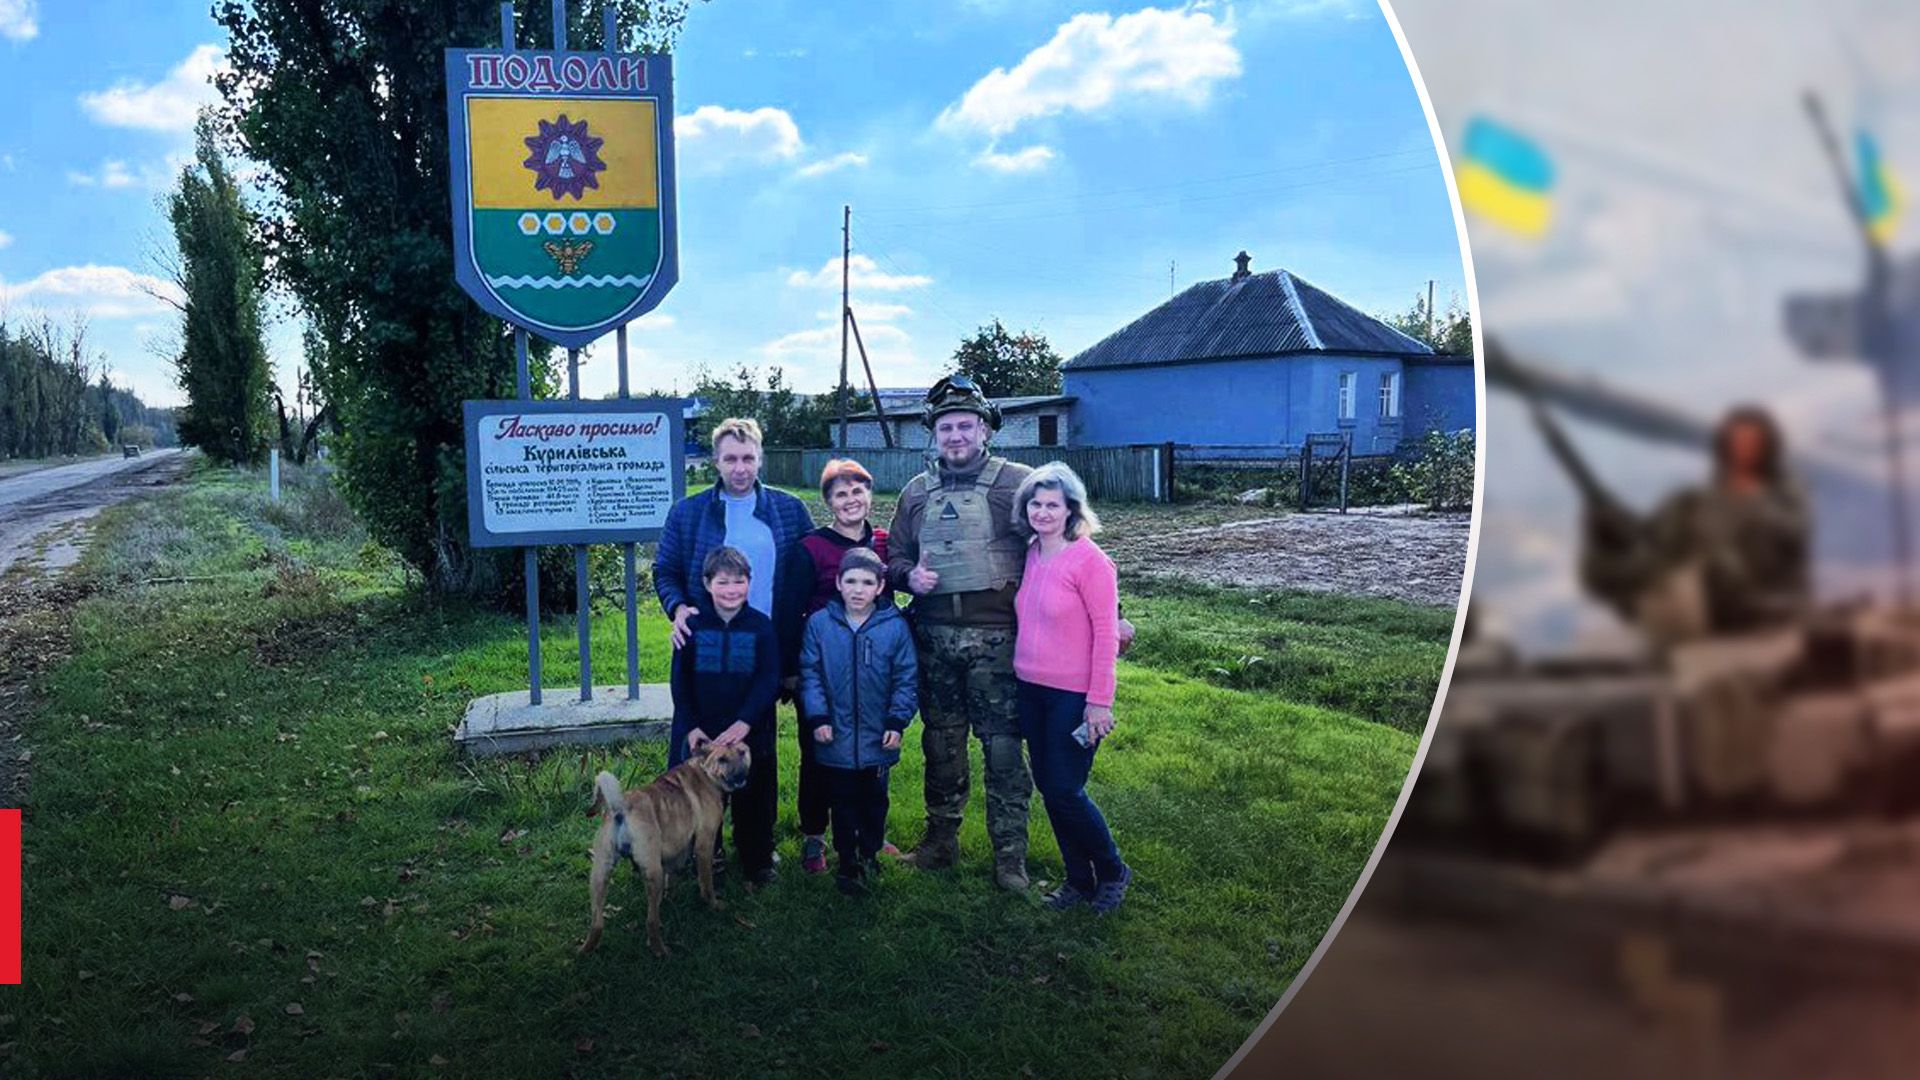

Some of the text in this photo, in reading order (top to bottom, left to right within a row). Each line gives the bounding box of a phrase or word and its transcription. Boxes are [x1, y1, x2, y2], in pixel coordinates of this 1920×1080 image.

[466, 54, 648, 93] ПОДОЛИ
[494, 415, 663, 442] Ласкаво просимо!
[523, 444, 627, 463] Курилівська
[484, 460, 666, 474] сільська територіальна громада
